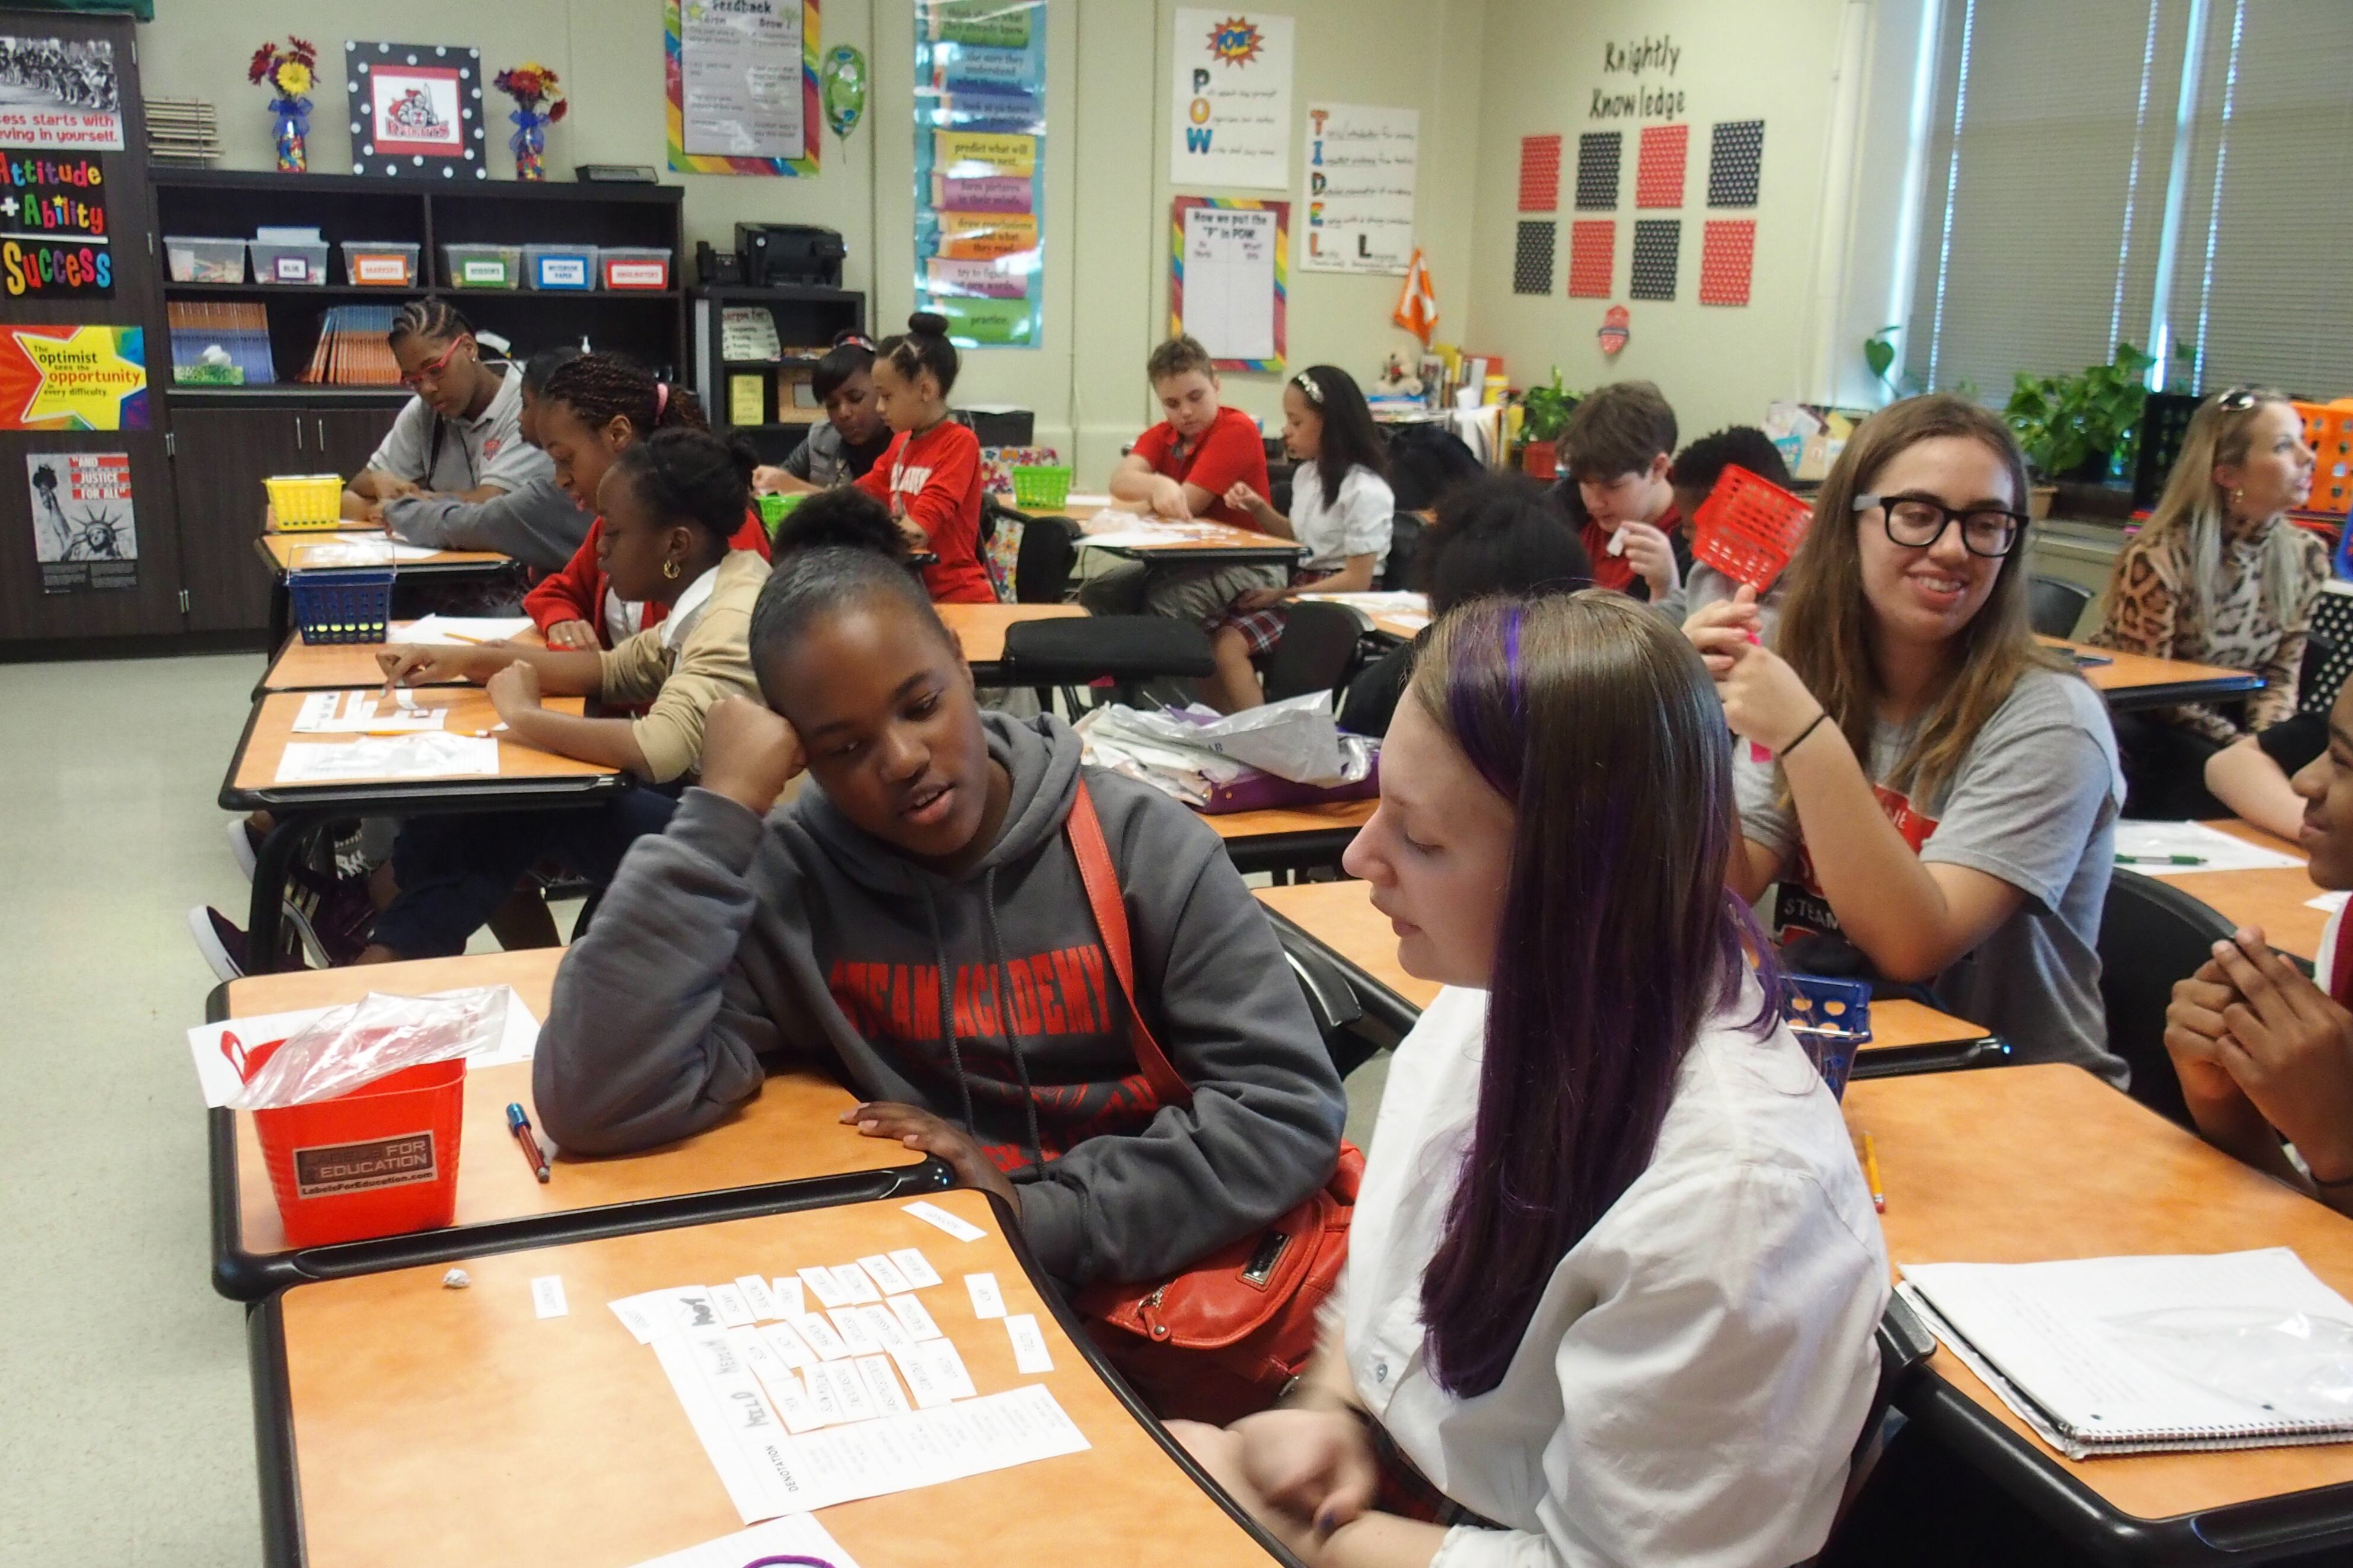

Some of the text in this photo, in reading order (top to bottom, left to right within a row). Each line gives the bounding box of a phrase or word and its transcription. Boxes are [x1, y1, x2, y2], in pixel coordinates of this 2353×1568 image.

[1603, 36, 1680, 75] Knightly
[1589, 83, 1685, 120] Knowledge
[0, 113, 114, 127] ess starts with
[40, 128, 52, 140] in
[56, 131, 118, 143] yourself.
[0, 152, 102, 187] Attitude
[24, 194, 104, 234] Ability
[2, 241, 112, 296] Success
[39, 350, 98, 368] optimist
[49, 369, 141, 387] opportunity
[44, 389, 66, 398] every
[81, 472, 118, 484] JUSTICE
[81, 487, 99, 500] FOR
[953, 944, 1113, 1039] ACADEMY
[387, 1140, 426, 1157] FOR
[320, 1153, 428, 1179] EDUCATION
[302, 1171, 433, 1195] LabelsForEducation.com
[700, 1337, 741, 1377] MEDIUM
[728, 1389, 771, 1429] MILD
[764, 1444, 799, 1492] DENOTATION
